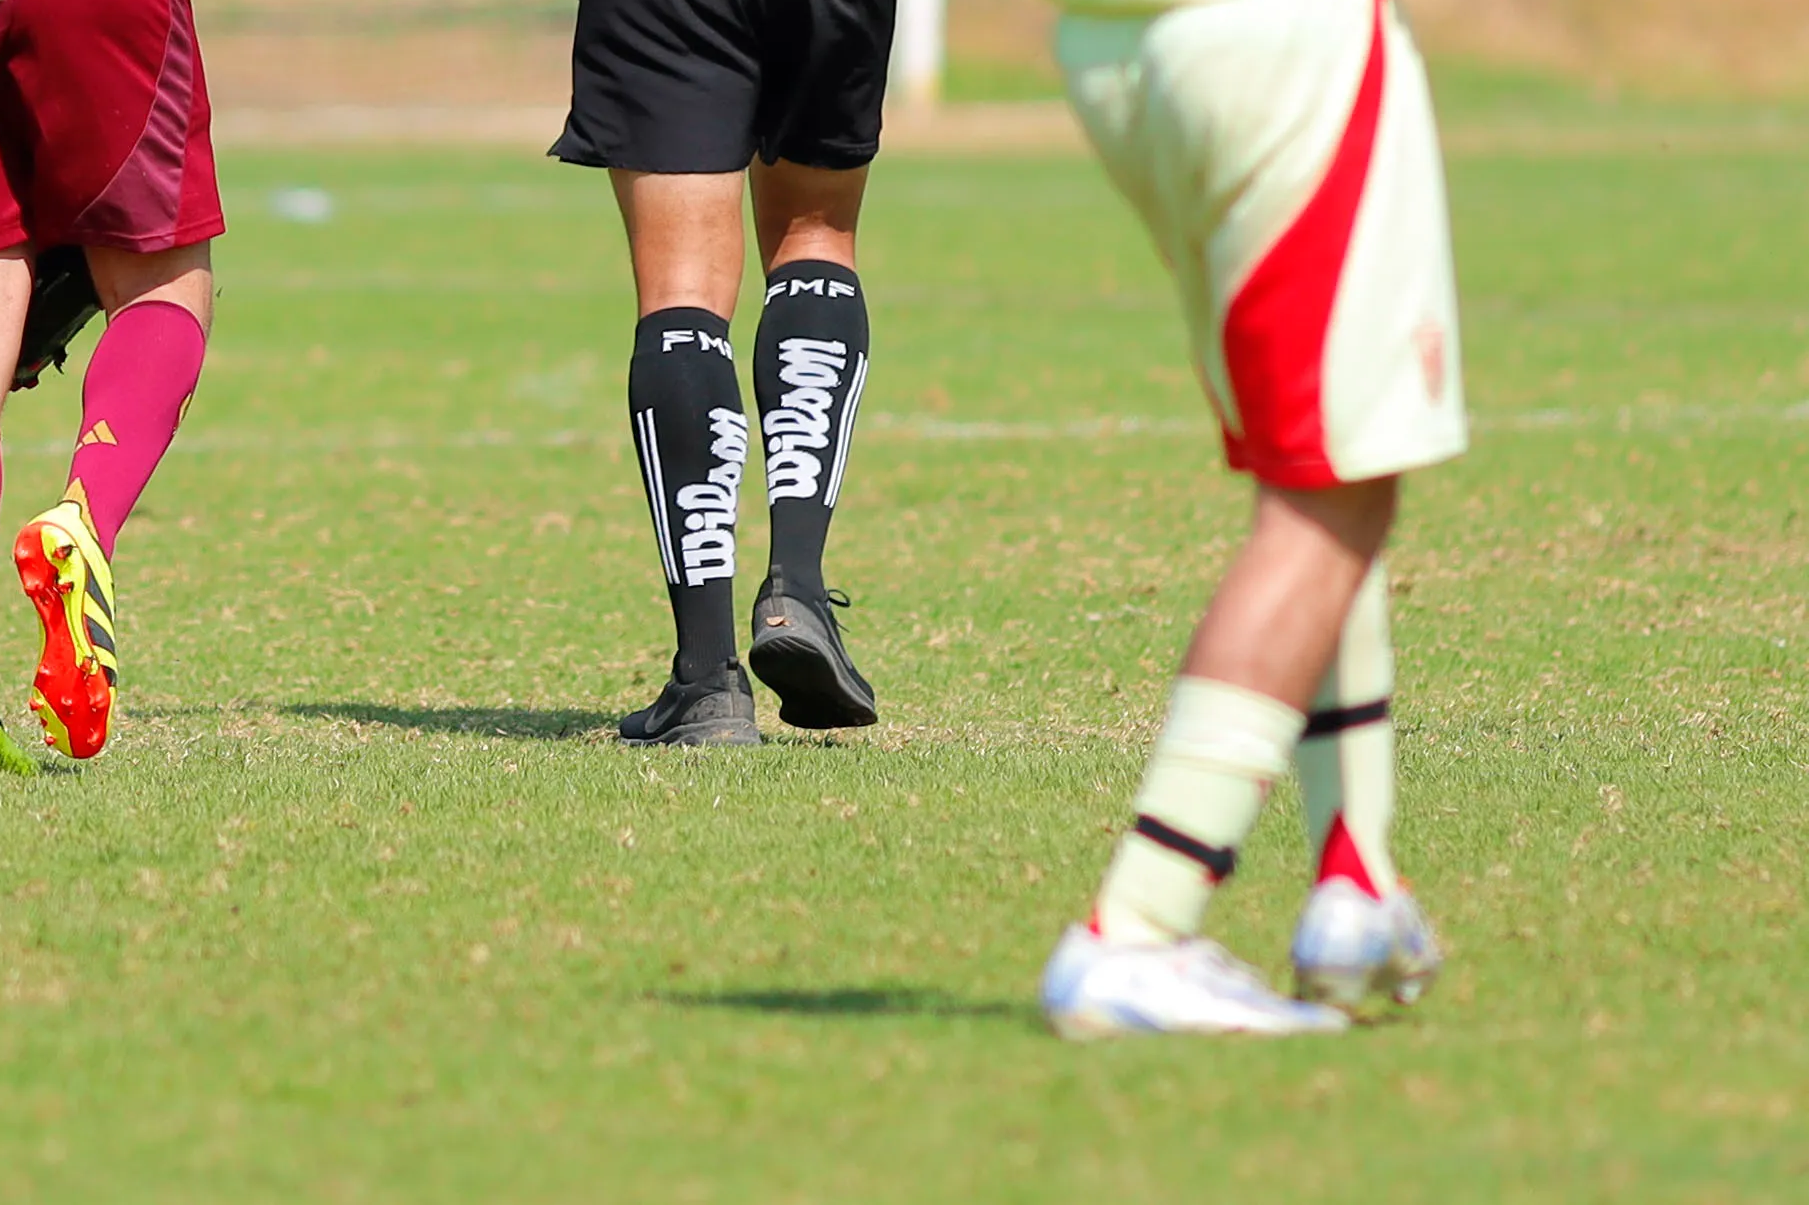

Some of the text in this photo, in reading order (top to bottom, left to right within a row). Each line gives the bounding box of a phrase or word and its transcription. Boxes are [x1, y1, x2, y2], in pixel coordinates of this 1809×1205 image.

[765, 278, 855, 305] FMF
[676, 407, 749, 586] Wilson
[763, 337, 847, 505] Wilson
